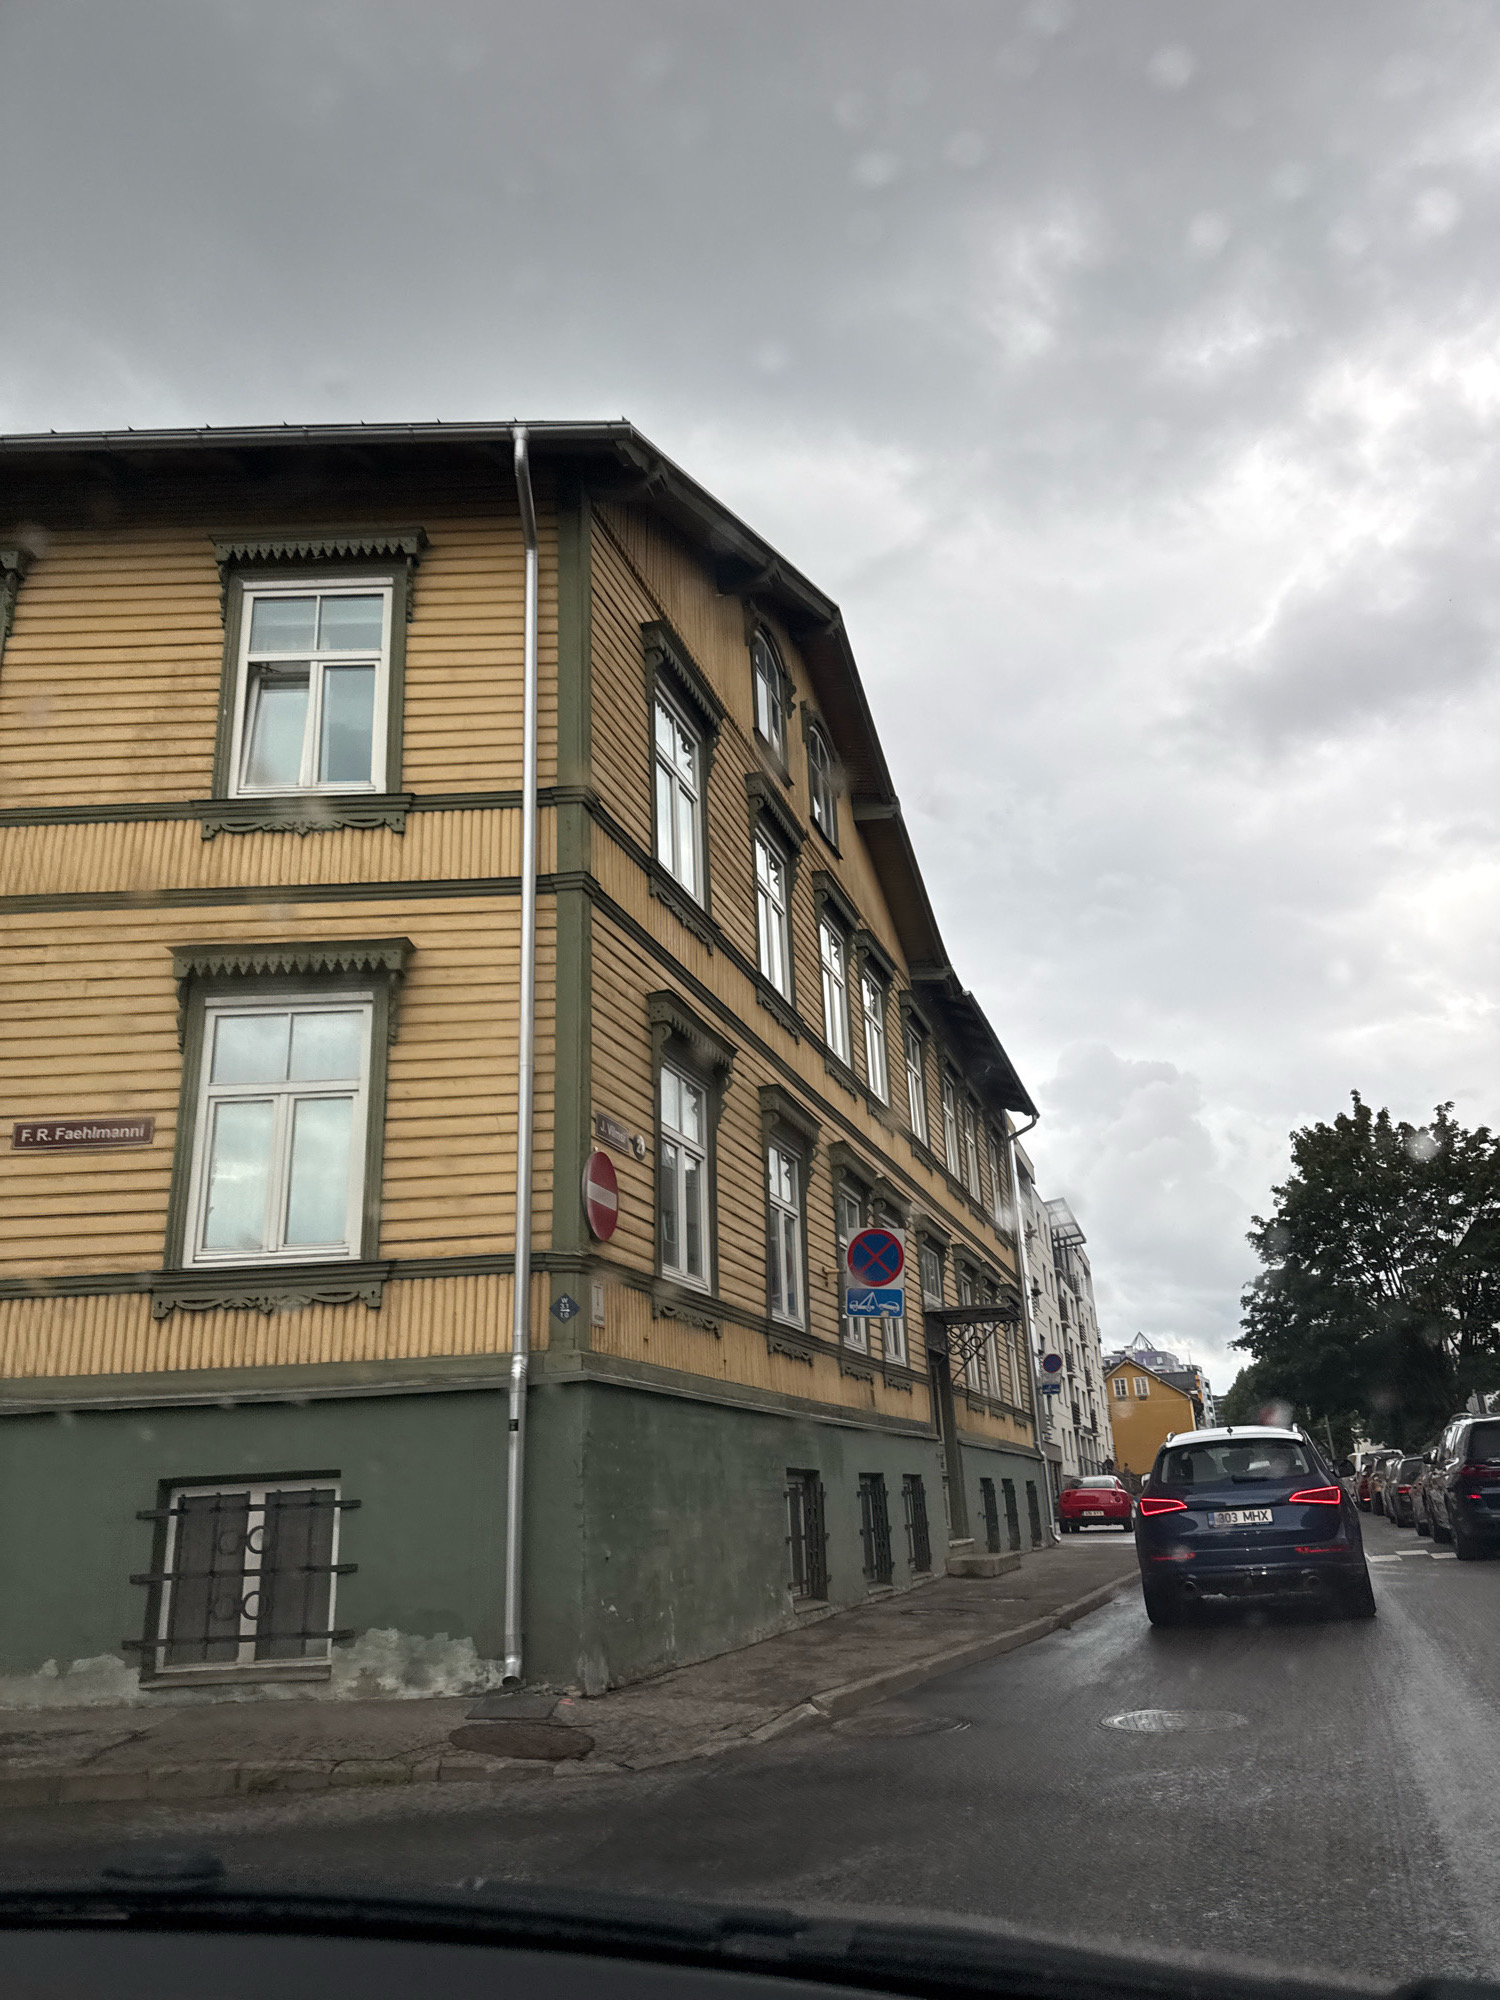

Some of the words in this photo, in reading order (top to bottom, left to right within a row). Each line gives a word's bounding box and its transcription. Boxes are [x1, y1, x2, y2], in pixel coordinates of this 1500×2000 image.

[21, 1129, 33, 1143] F.
[36, 1128, 52, 1143] R.
[54, 1124, 145, 1141] Faehlmanni
[1218, 1512, 1238, 1523] 303
[1242, 1511, 1269, 1522] MHX
